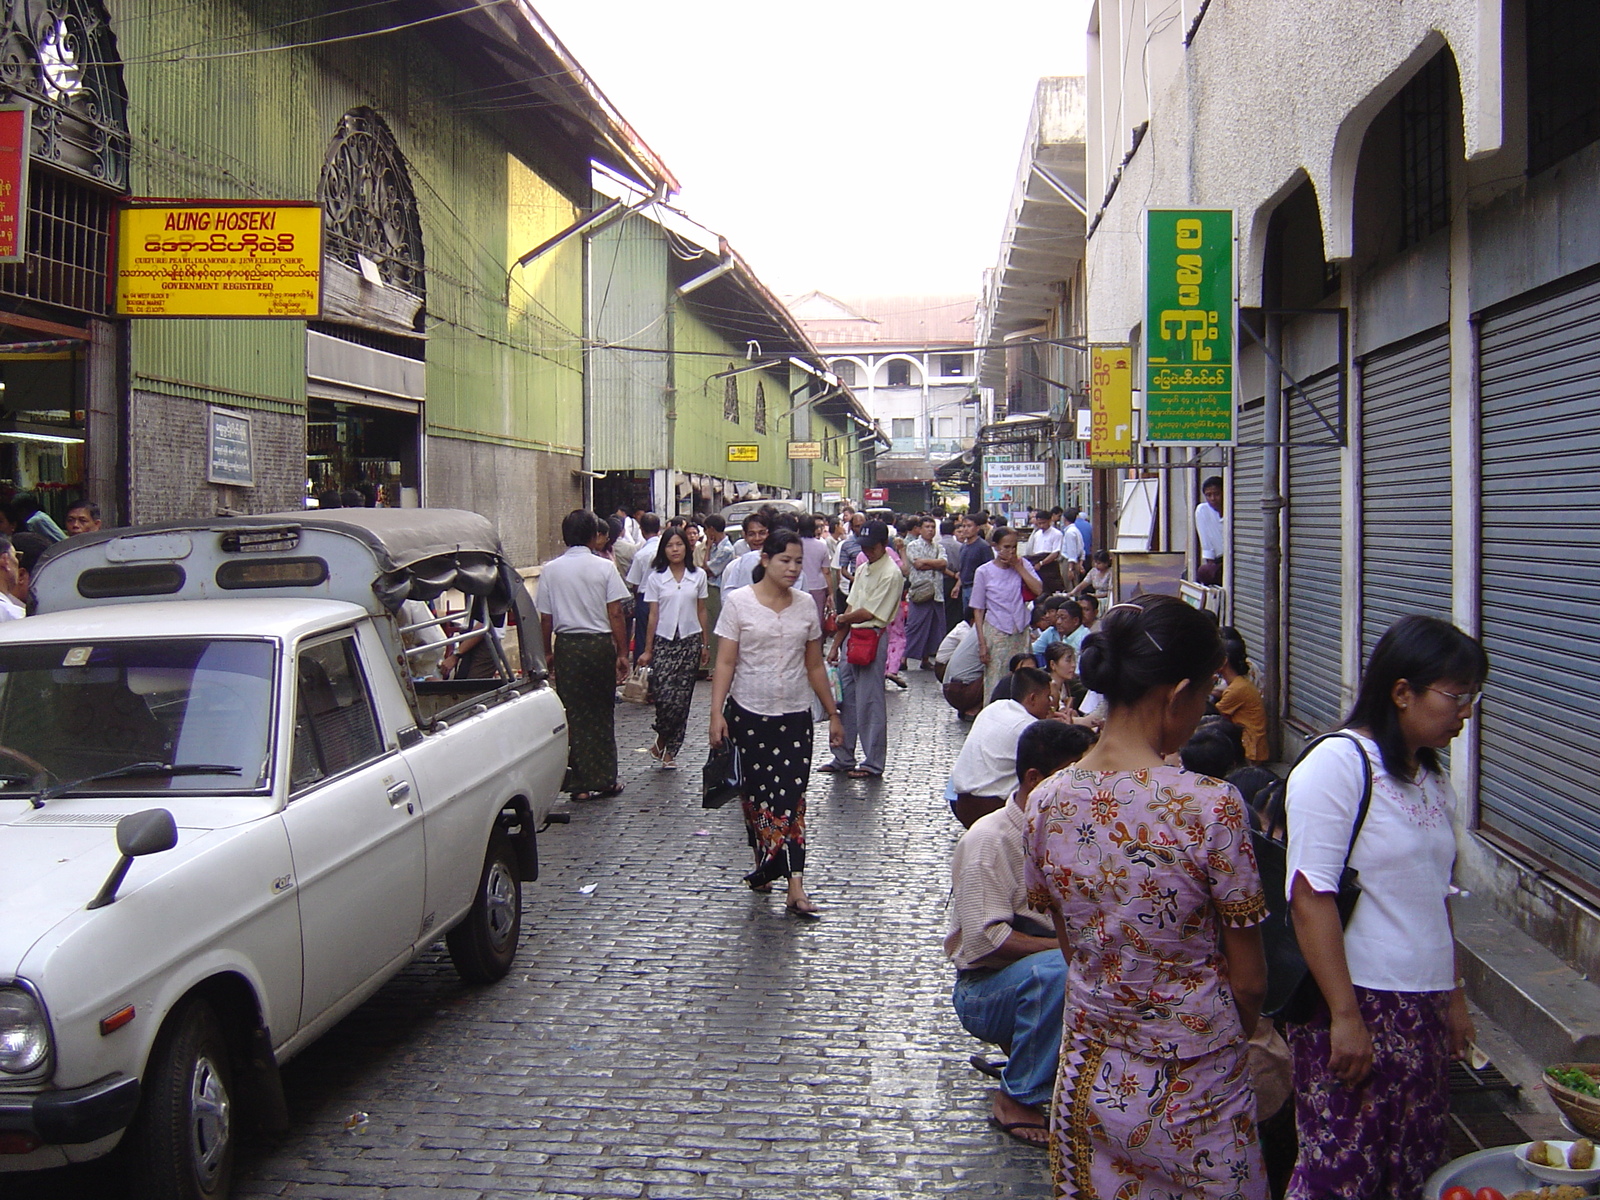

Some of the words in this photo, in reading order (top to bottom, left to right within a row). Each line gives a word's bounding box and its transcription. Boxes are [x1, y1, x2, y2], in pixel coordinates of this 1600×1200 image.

[164, 211, 211, 231] AUNG
[214, 211, 277, 231] HOSEKI
[239, 257, 282, 265] JEWELLERY
[161, 282, 219, 290] GOVERNMENT
[222, 282, 274, 291] REGISTERED
